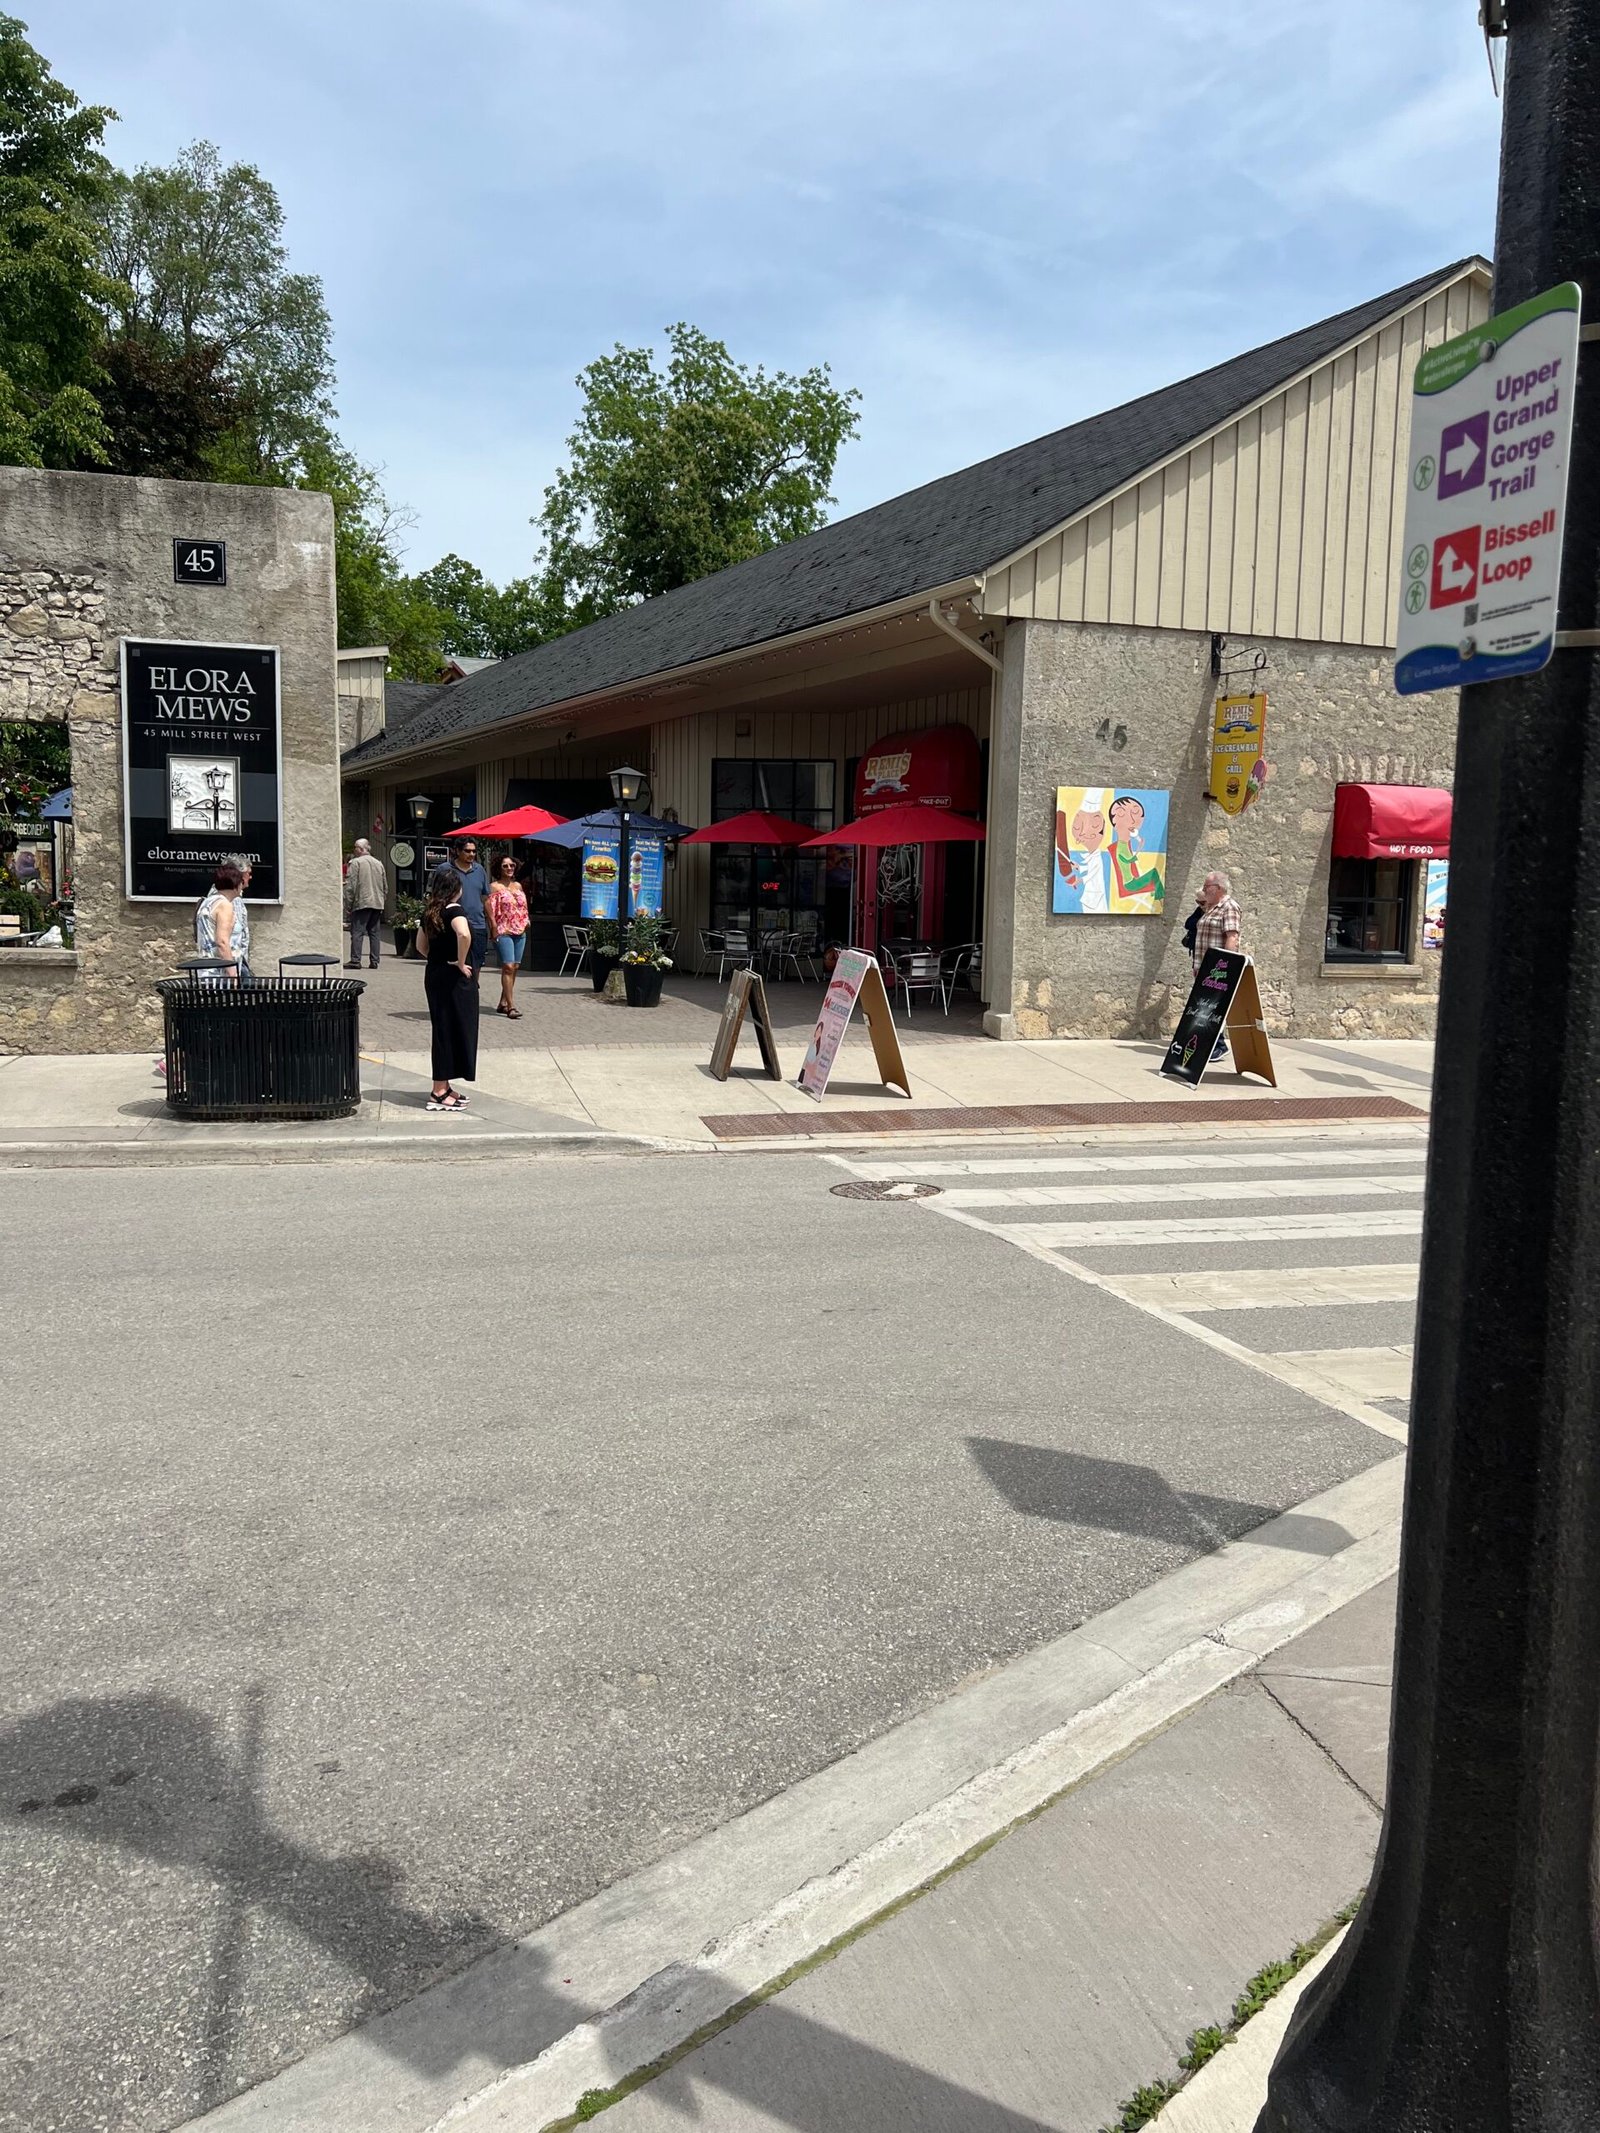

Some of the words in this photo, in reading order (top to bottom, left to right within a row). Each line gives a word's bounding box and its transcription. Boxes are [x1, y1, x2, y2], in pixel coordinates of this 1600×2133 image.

[1496, 358, 1562, 402] Upper
[1493, 388, 1559, 435] Grand
[1491, 430, 1555, 469] Gorge
[1488, 465, 1536, 501] Trail
[1485, 509, 1556, 552] Bissell
[184, 548, 215, 573] 45
[1482, 556, 1533, 585] Loop
[148, 666, 257, 695] ELORA
[155, 695, 252, 722] MEWS
[143, 729, 156, 737] 45
[161, 729, 186, 738] MILL
[191, 730, 229, 740] STREET
[233, 732, 261, 741] WEST
[1095, 717, 1128, 753] 45
[1215, 743, 1224, 753] ICE
[1225, 743, 1245, 753] CREAM
[1245, 743, 1258, 752] BAR
[1225, 765, 1242, 774] GRILL
[147, 846, 261, 863] eloramewscom
[1389, 844, 1406, 855] HOT
[1409, 845, 1434, 854] FOOD
